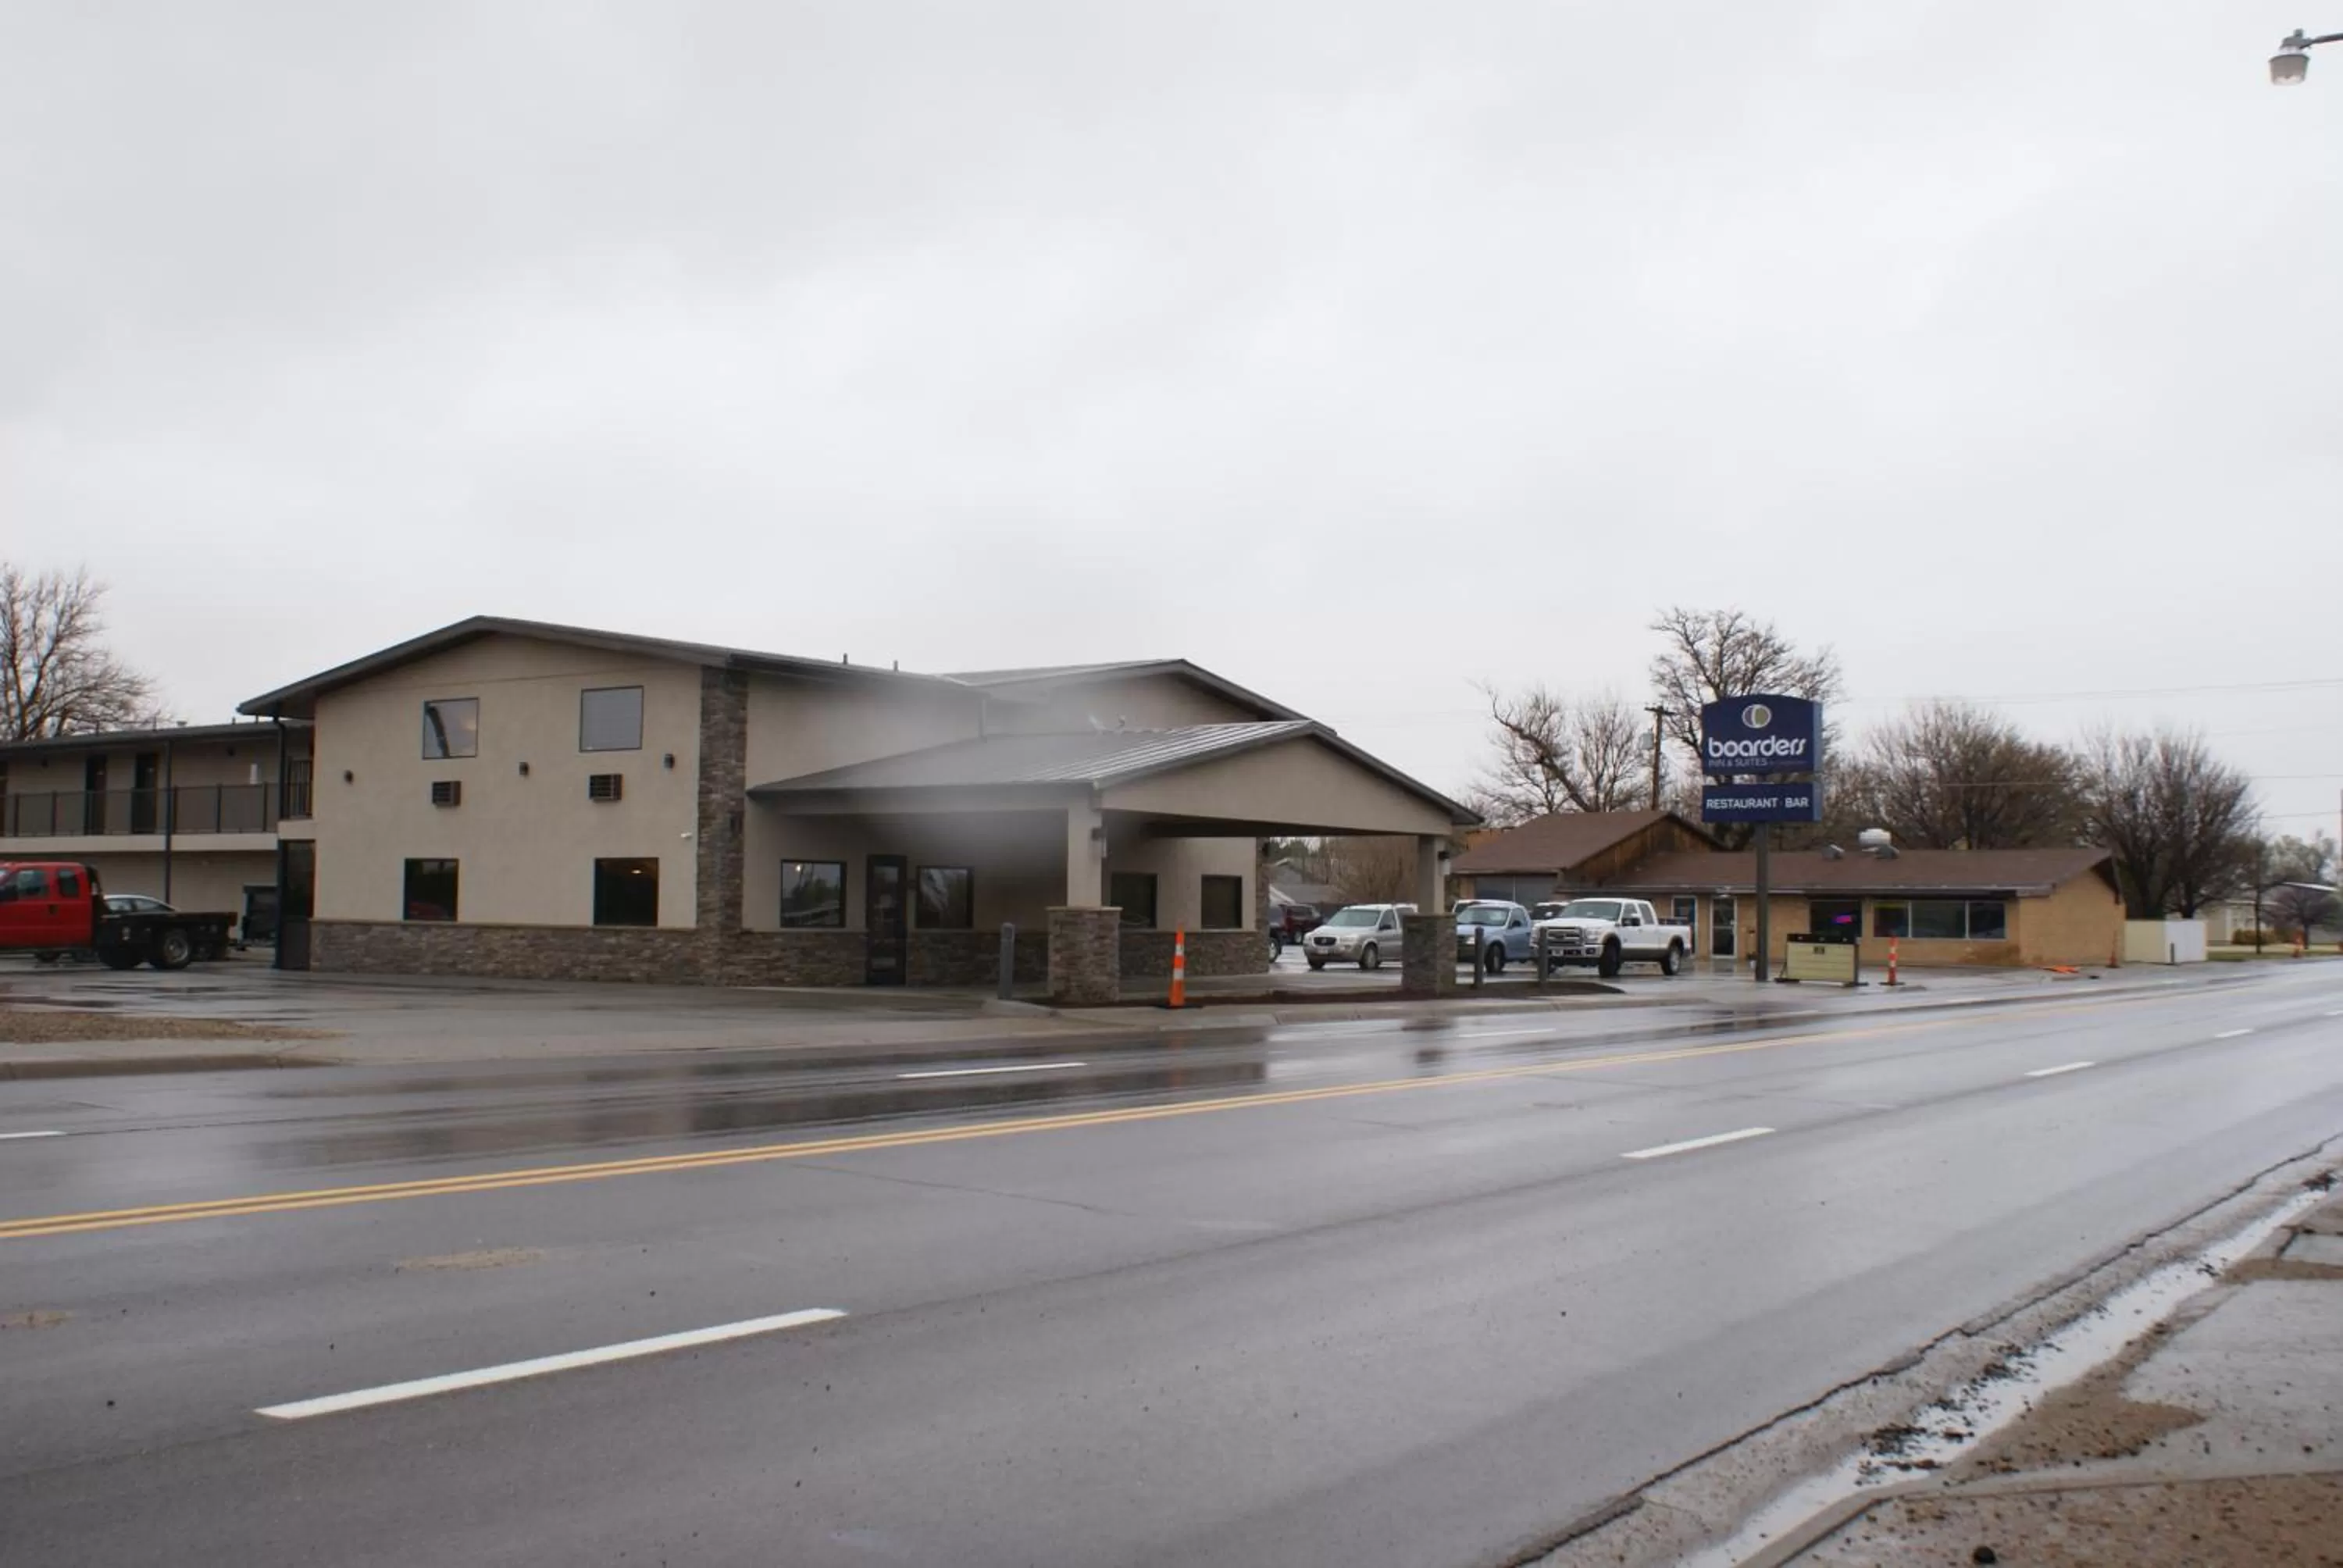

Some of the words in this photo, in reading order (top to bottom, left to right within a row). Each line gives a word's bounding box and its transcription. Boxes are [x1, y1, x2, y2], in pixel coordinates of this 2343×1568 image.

[1708, 735, 1806, 757] boarders
[1735, 758, 1768, 767] SUITES
[1706, 797, 1778, 809] RESTAURANT
[1785, 796, 1809, 808] BAR
